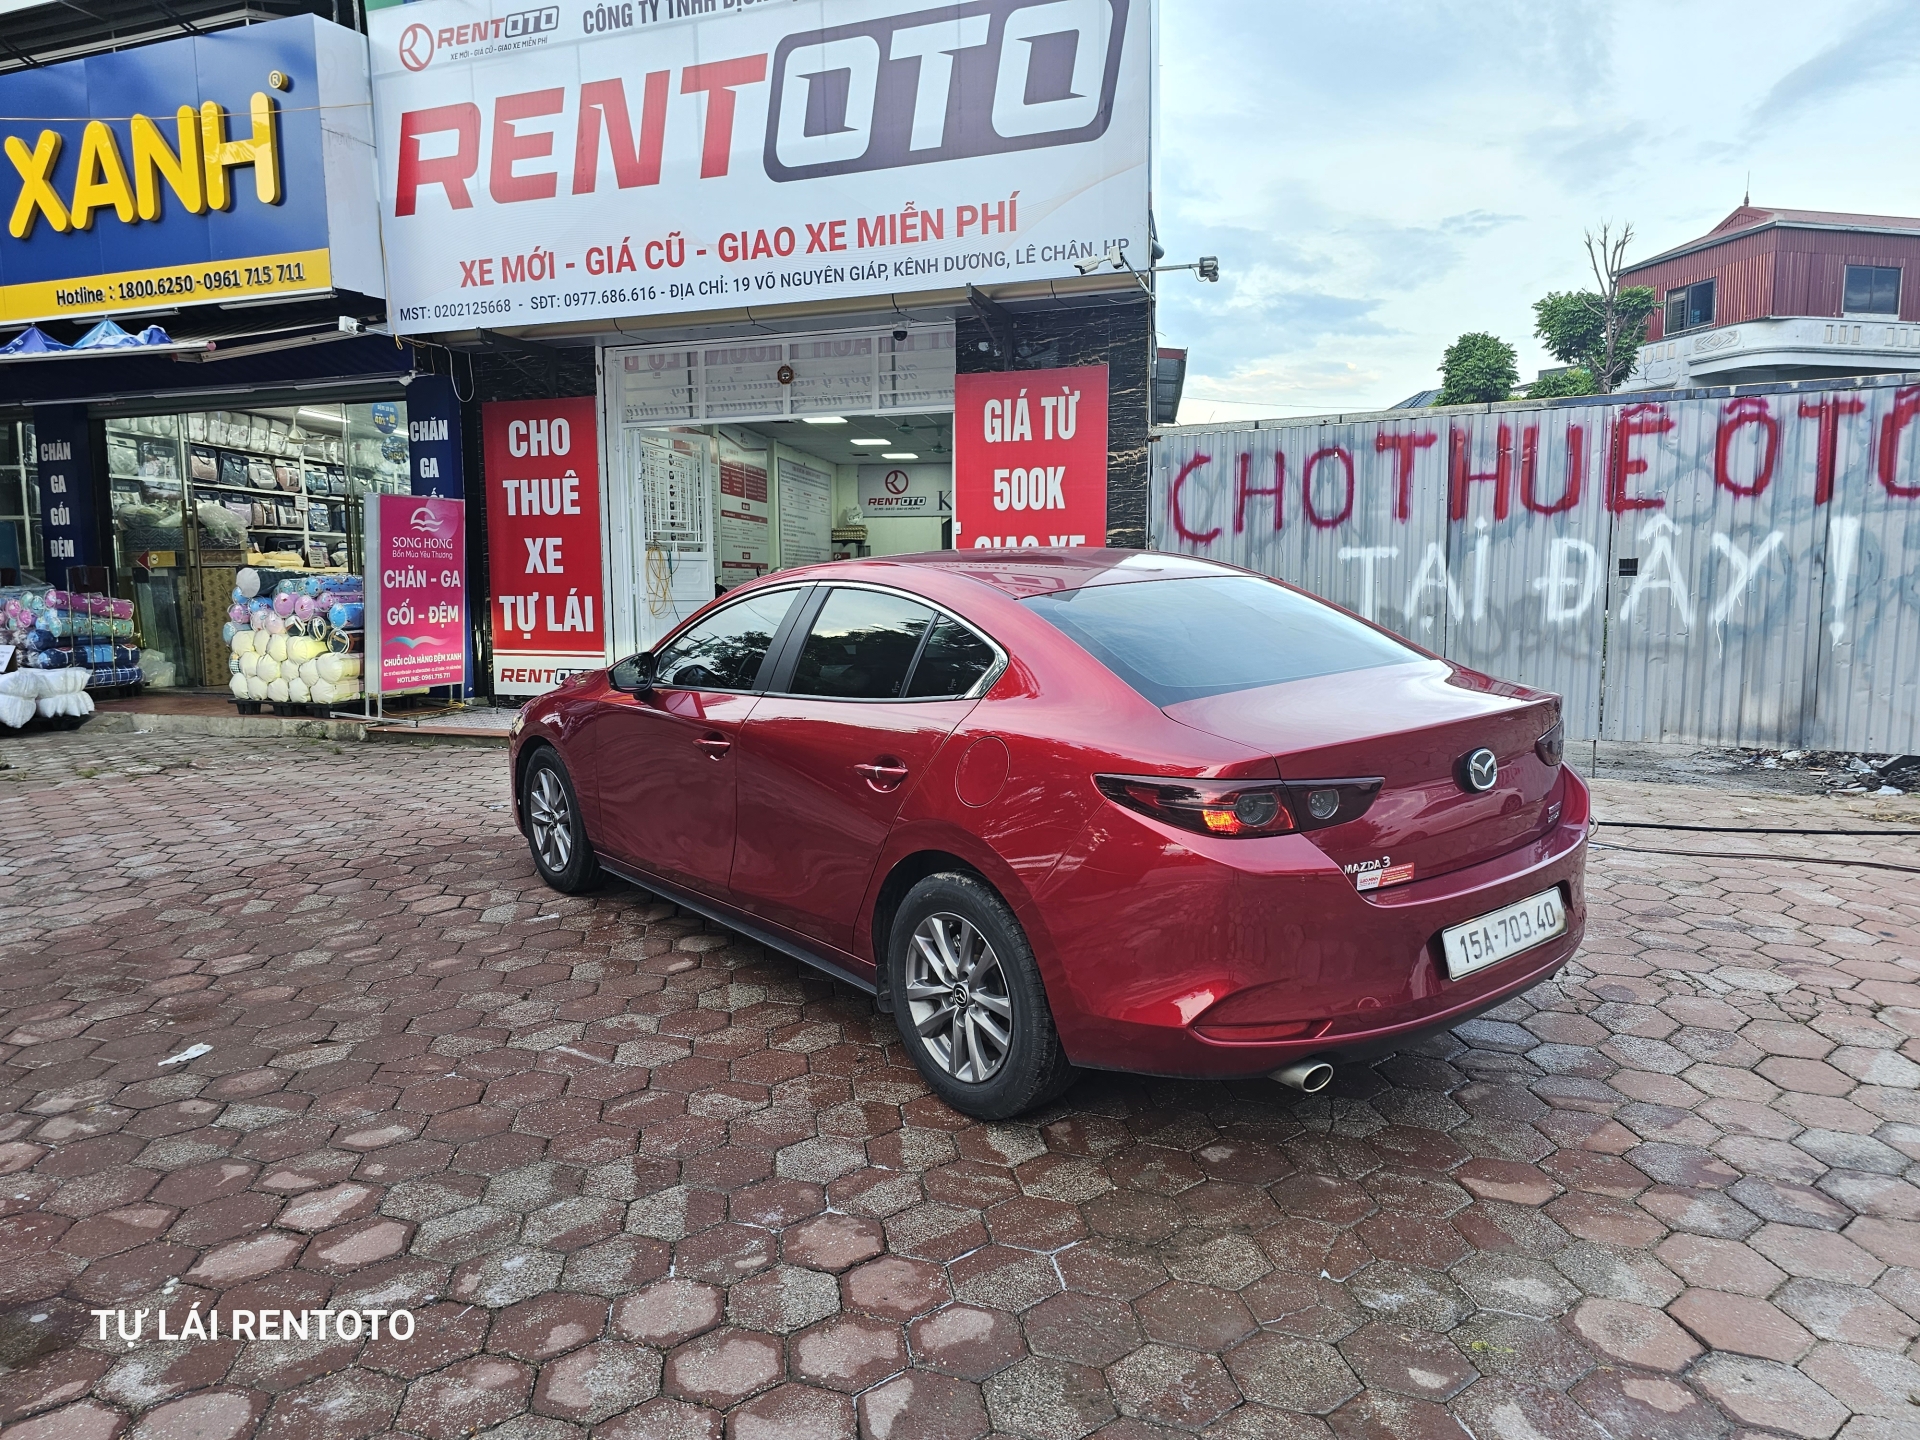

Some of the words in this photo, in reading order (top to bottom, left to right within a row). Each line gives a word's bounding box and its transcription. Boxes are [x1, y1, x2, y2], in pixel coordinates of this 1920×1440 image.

[436, 6, 559, 49] RENTOTO
[583, 2, 633, 34] CÔNG
[638, 0, 659, 24] TY
[450, 53, 458, 61] XE
[498, 43, 512, 52] GIAO
[513, 41, 521, 49] XE
[537, 35, 548, 45] PHÍ
[395, 0, 1120, 217] RENTOTO
[4, 91, 281, 240] XANH
[459, 258, 495, 288] XE
[501, 246, 556, 284] MỚI
[585, 236, 637, 276] GIÁ
[645, 231, 686, 270] CŨ
[717, 226, 796, 263] GIAO
[805, 219, 847, 254] XE
[857, 201, 945, 249] MIỄN
[956, 190, 1021, 239] PHÍ
[56, 286, 105, 307] Hotline
[118, 274, 195, 300] 1800.6250
[203, 268, 242, 291] 0961
[244, 265, 274, 287] 715
[276, 261, 306, 284] 711
[400, 306, 431, 321] MST:
[434, 299, 511, 318] 0202125668
[530, 294, 560, 310] SĐT:
[564, 286, 656, 308] 0977.686.616
[669, 282, 695, 300] ĐỊA
[699, 274, 729, 296] CHỈ:
[732, 276, 750, 293] 19
[755, 271, 776, 290] VÕ
[780, 265, 845, 288] NGUYÊN
[849, 259, 889, 282] GIÁP,
[893, 254, 939, 278] KÊNH
[944, 249, 1011, 272] DƯƠNG,
[1016, 243, 1037, 265] LÊ
[409, 416, 449, 442] CHĂN
[983, 388, 1032, 443] GIÁ
[1041, 386, 1081, 441] TỪ
[41, 439, 71, 461] CHĂN
[508, 417, 571, 458] CHO
[50, 474, 67, 493] GA
[419, 457, 440, 478] GA
[502, 469, 581, 517] THUÊ
[868, 497, 926, 506] RENTOTO
[993, 466, 1066, 511] 500K
[50, 501, 71, 526] GỐI
[50, 536, 75, 560] ĐỆM
[392, 536, 421, 549] SONG
[424, 538, 453, 549] HONG
[524, 537, 564, 574] XE
[383, 564, 427, 589] CHĂN
[440, 569, 461, 589] GA
[386, 598, 415, 626] GỐI
[428, 601, 459, 629] ĐỆM
[499, 591, 540, 640] TỰ
[546, 587, 594, 632] LÁI
[501, 668, 596, 685] RENTO
[1344, 859, 1381, 875] MAZDA
[1382, 855, 1391, 868] 3
[1459, 901, 1556, 964] 15A-703.40
